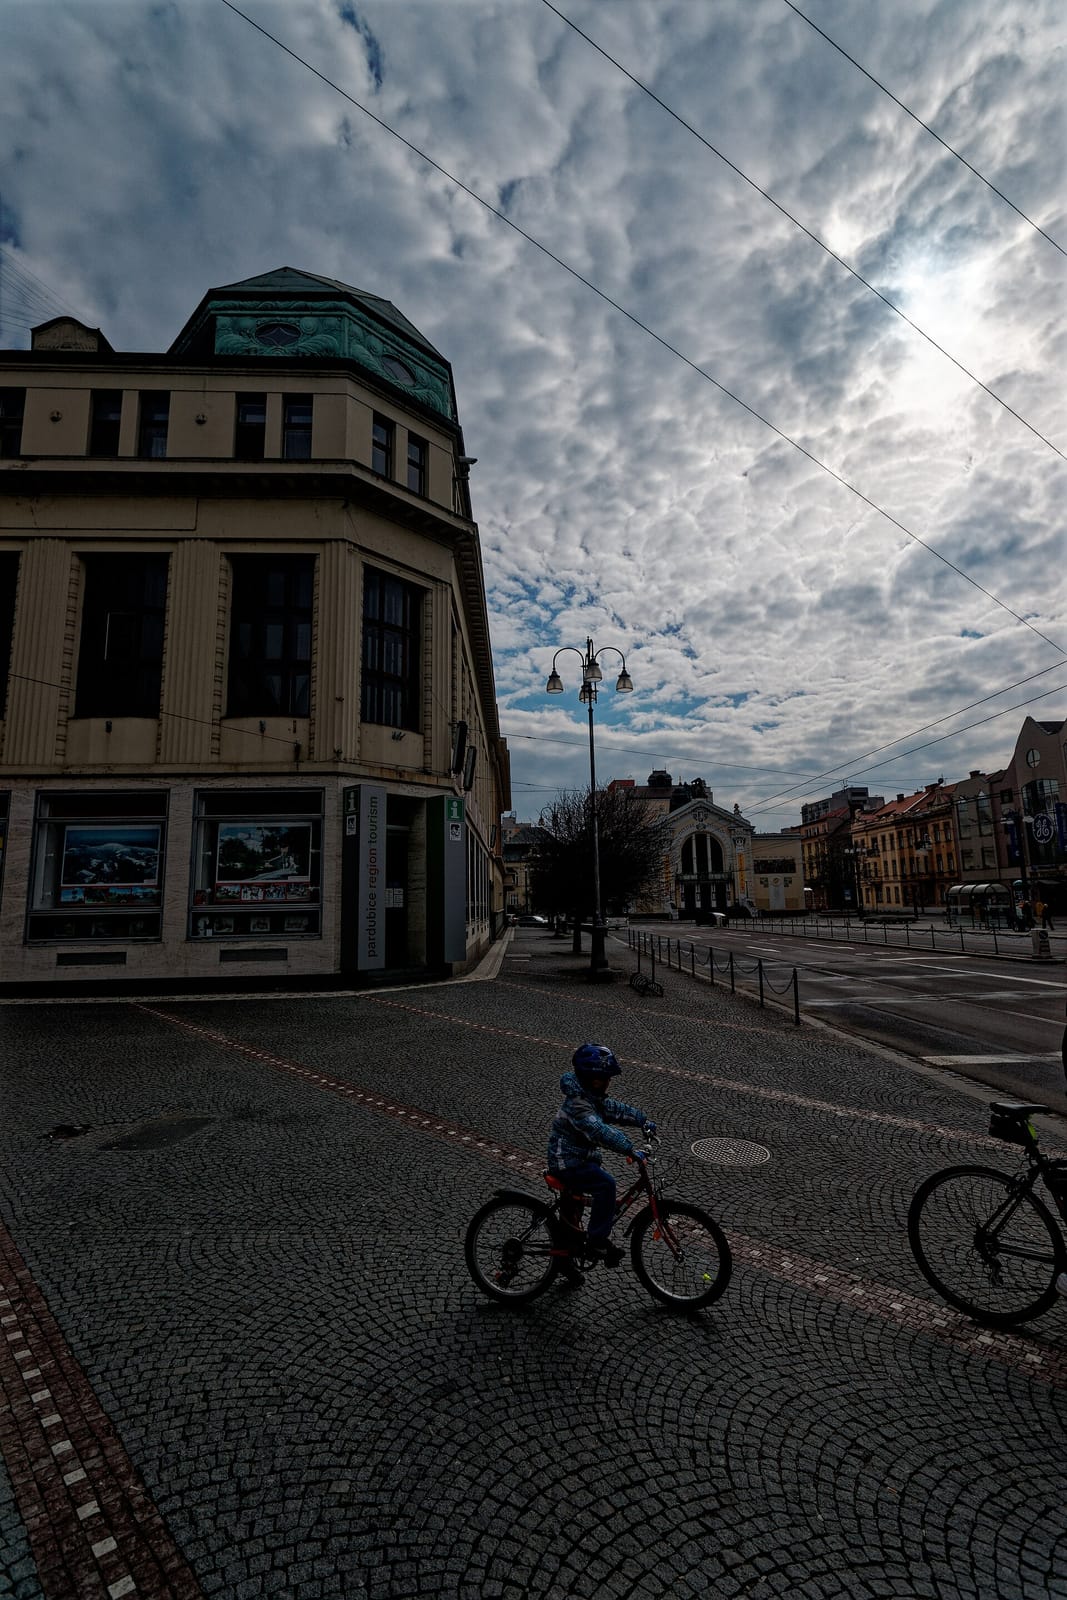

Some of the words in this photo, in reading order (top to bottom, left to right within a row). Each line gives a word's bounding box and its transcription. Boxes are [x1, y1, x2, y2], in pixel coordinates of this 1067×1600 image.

[367, 795, 378, 844] tourism
[368, 847, 379, 889] region
[366, 891, 378, 958] pardubice
